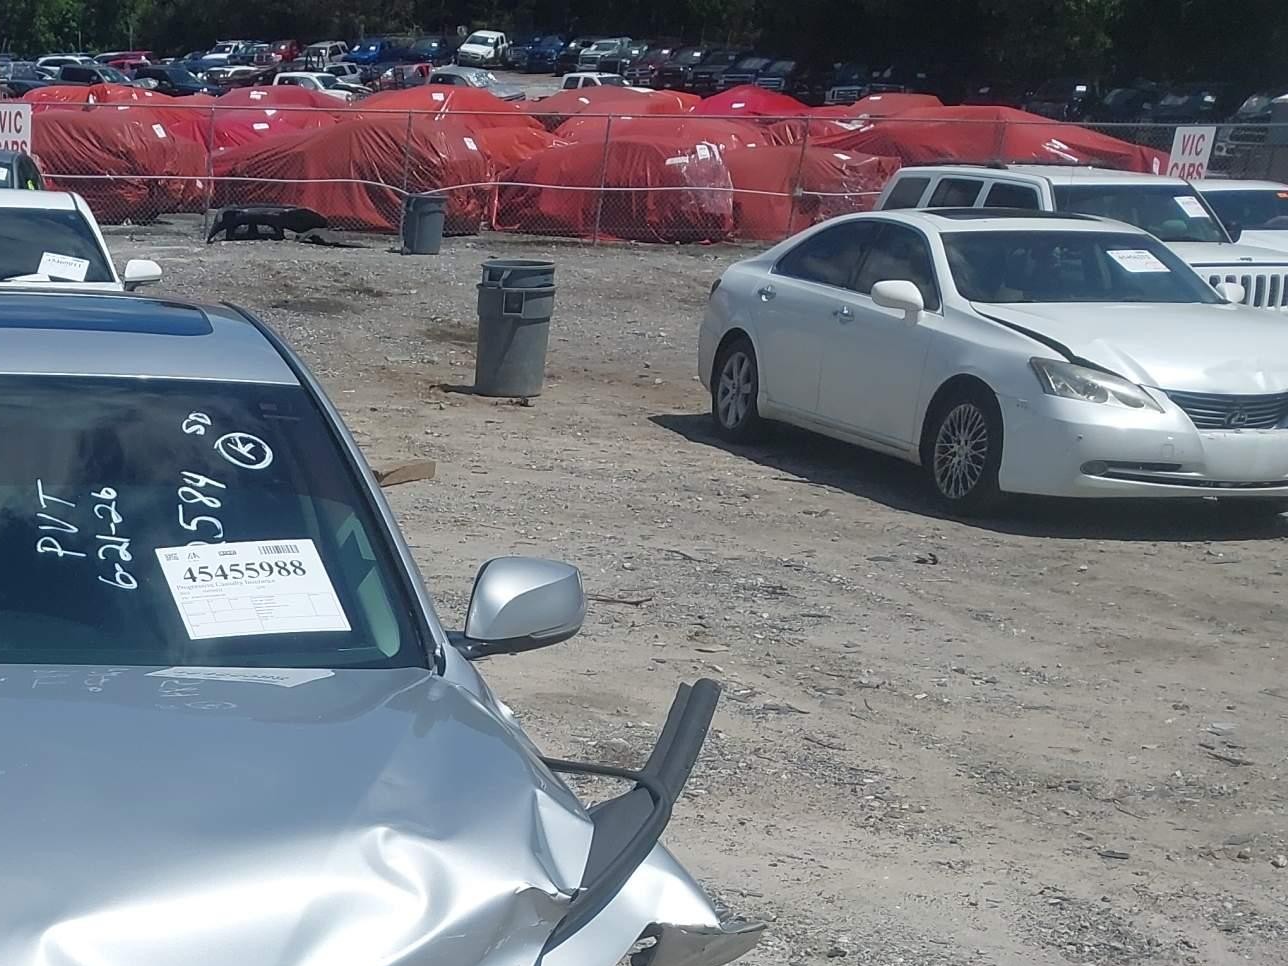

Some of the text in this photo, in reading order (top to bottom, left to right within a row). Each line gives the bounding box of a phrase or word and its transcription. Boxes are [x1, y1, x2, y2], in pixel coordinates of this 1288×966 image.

[1181, 133, 1206, 156] VIC
[36, 479, 87, 557] PVT
[178, 471, 227, 546] 584
[183, 560, 306, 583] 45455988
